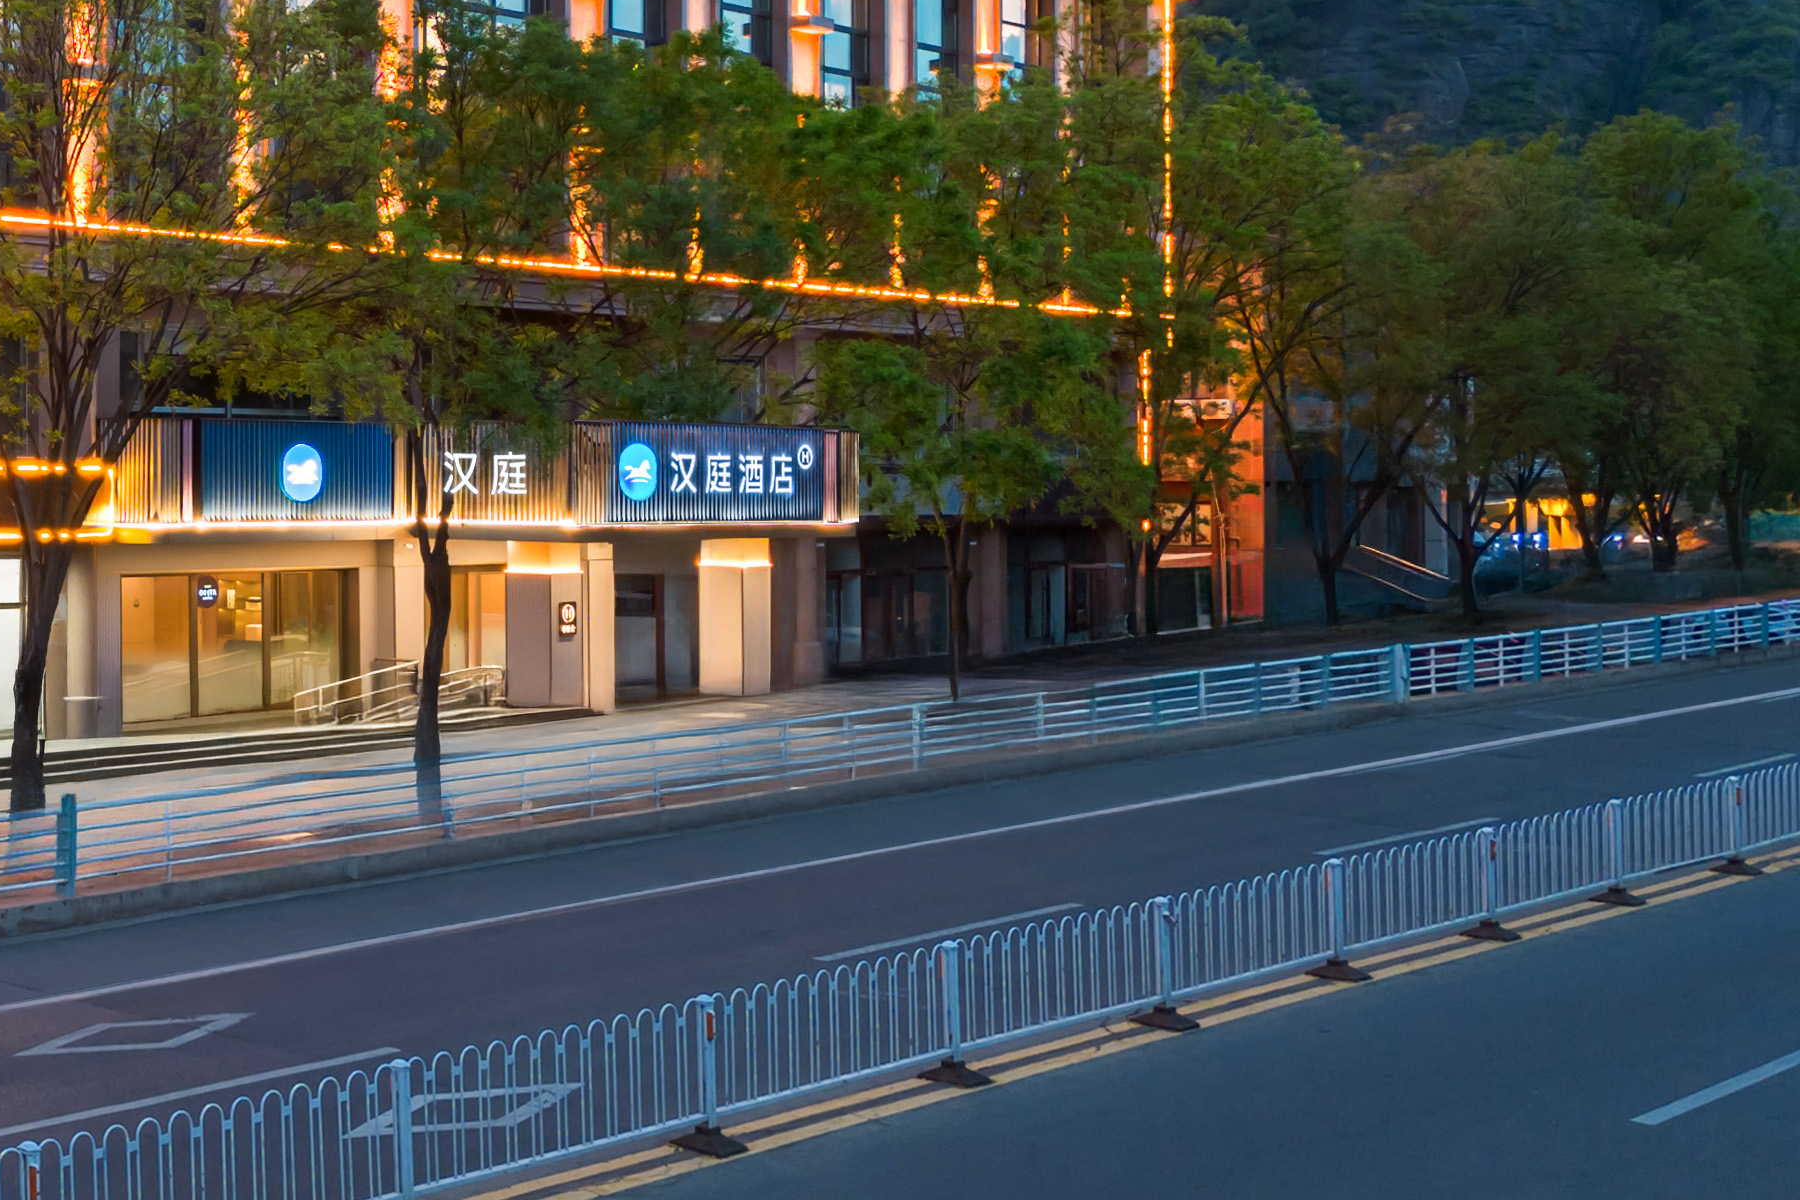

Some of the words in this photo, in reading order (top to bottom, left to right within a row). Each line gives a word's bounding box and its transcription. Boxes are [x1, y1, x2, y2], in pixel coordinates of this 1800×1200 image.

[443, 450, 527, 495] 汉庭
[670, 452, 794, 494] 汉庭酒店
